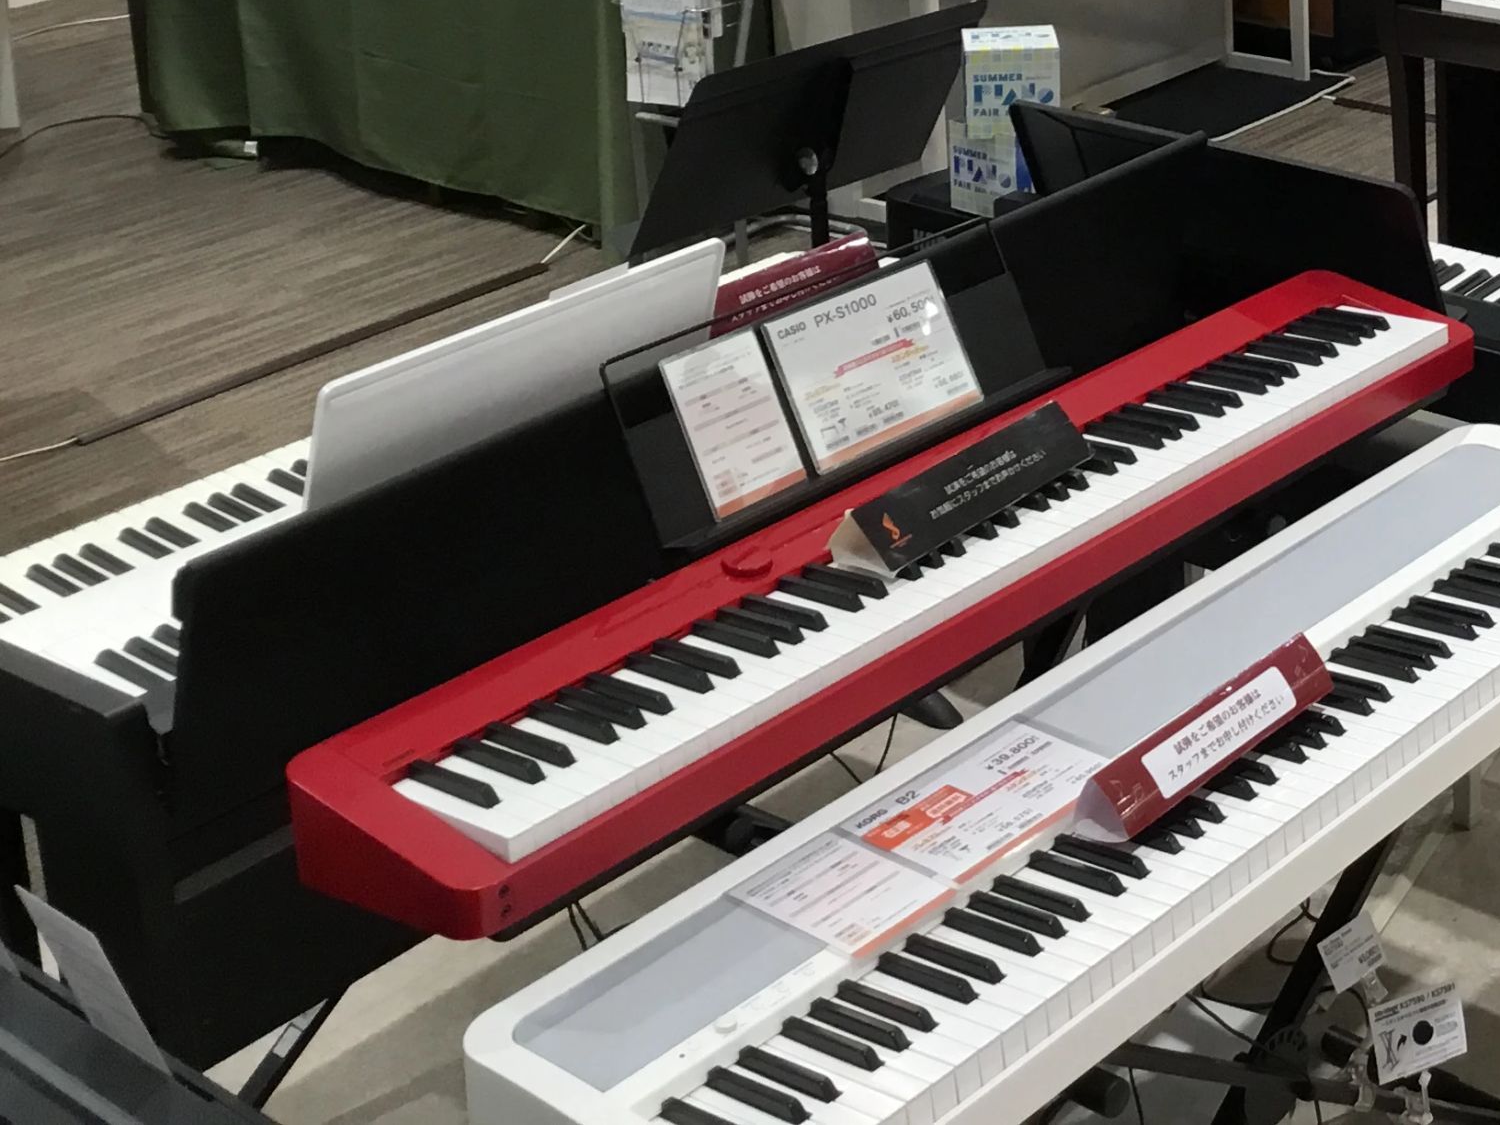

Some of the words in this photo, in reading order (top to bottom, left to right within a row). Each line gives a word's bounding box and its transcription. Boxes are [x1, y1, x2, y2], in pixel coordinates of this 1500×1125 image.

[972, 73, 1023, 83] SUMMER
[973, 82, 1054, 106] PIANO
[972, 107, 1000, 118] FAIR
[952, 144, 988, 161] SUMMER
[953, 178, 972, 191] FAIR
[776, 321, 808, 340] CASIO
[812, 292, 878, 328] PX-S1000
[1172, 688, 1262, 756] 試弾をご希望のお客様は
[1168, 694, 1286, 781] スタッフまでお申し付けください
[985, 736, 1037, 771] ¥39,800
[855, 808, 889, 829] KORG
[895, 789, 918, 806] B2
